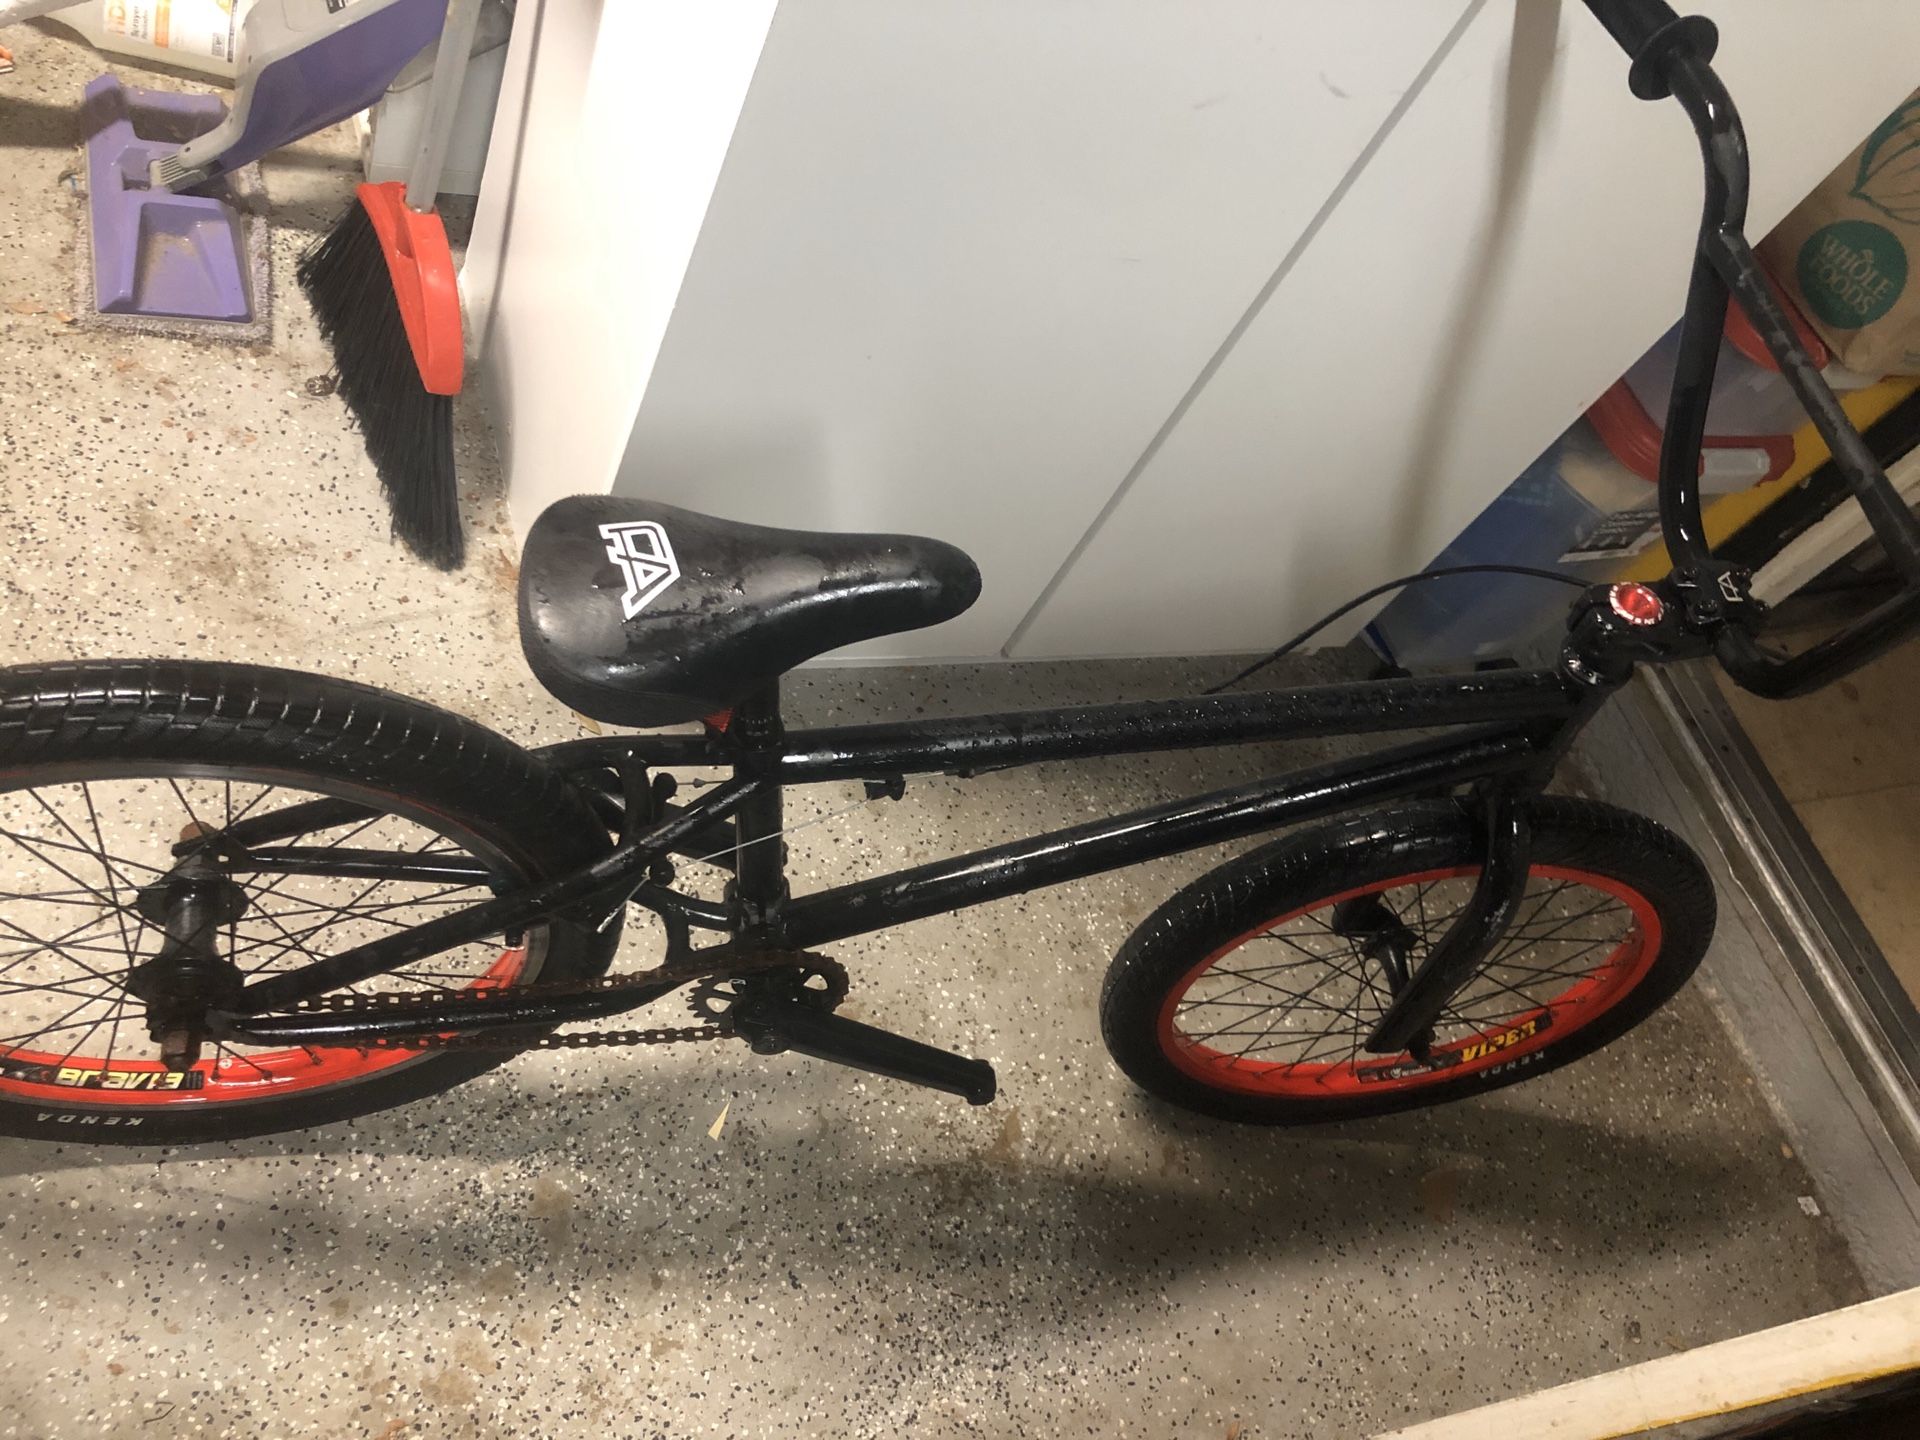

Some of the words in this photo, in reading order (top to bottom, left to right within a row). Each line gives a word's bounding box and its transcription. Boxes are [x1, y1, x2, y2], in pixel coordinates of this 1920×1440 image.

[1808, 256, 1877, 315] FOODS
[1820, 233, 1895, 300] WHOLE
[1460, 1019, 1537, 1063] VIPER
[1479, 1051, 1545, 1079] KENDA
[36, 1112, 145, 1127] KENDA
